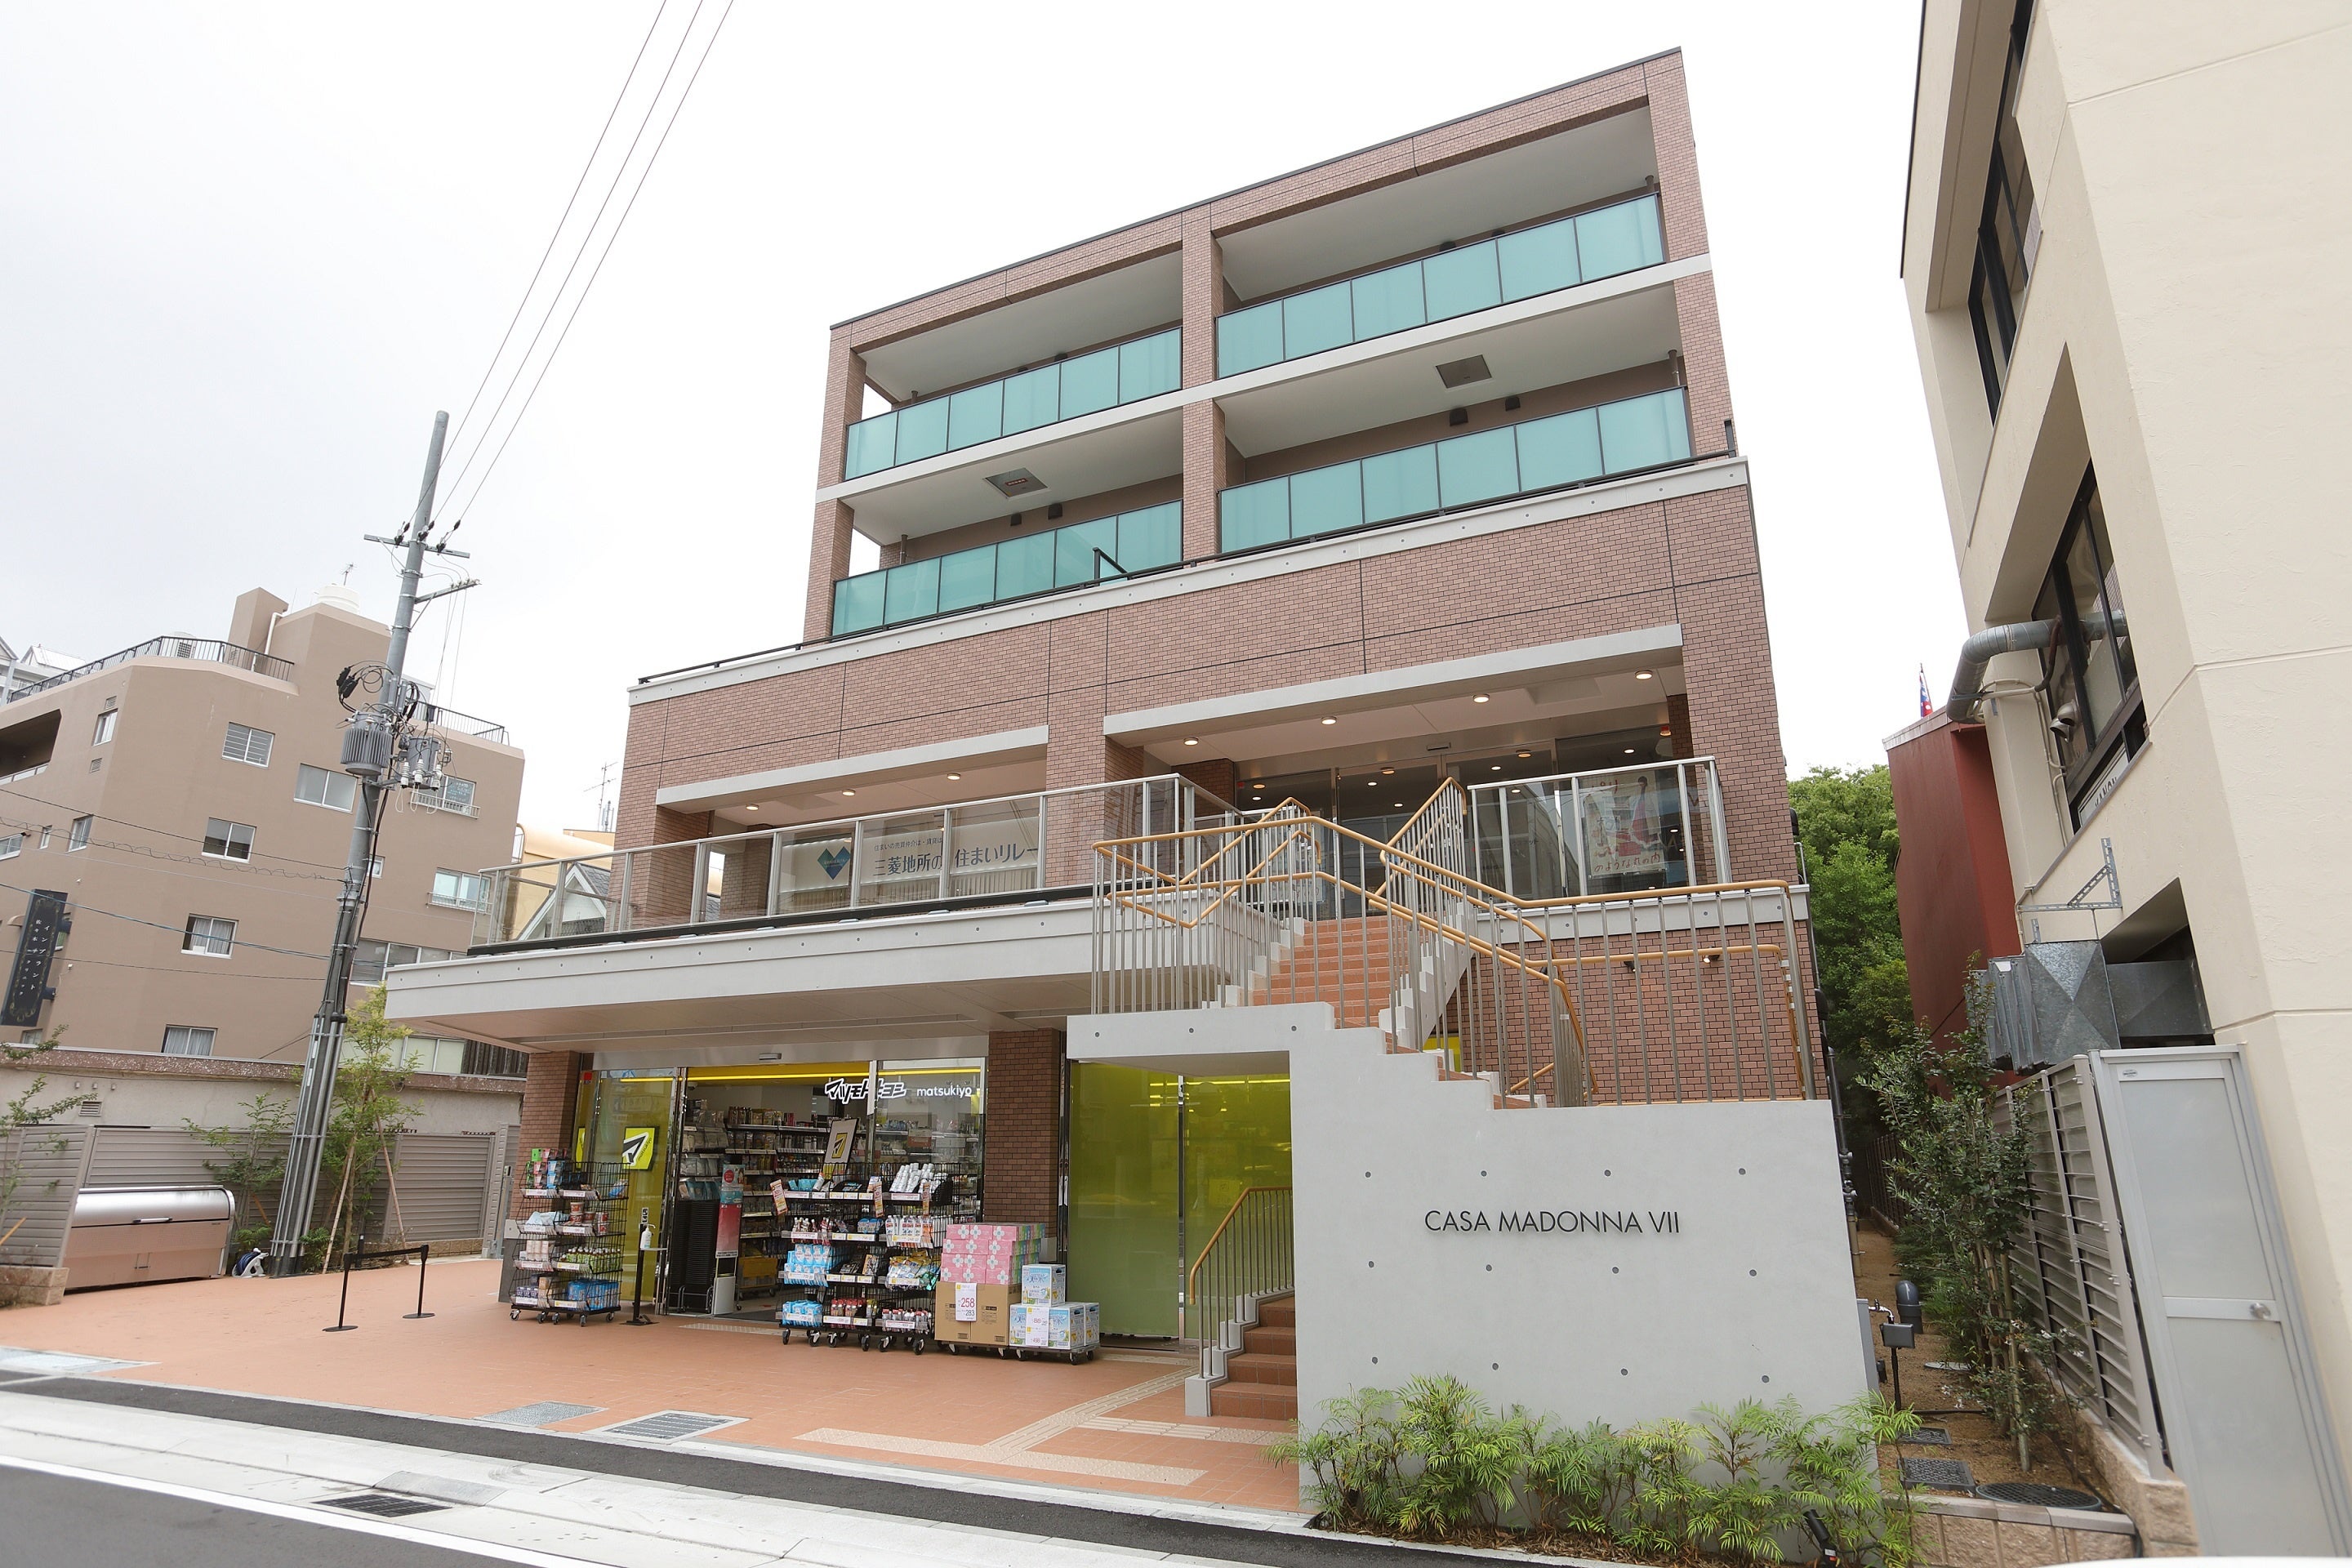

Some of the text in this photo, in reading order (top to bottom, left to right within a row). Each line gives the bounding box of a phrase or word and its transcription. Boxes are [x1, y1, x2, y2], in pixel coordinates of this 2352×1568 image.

[916, 1082, 973, 1099] matsukiyo
[1424, 1209, 1680, 1234] CASA MADONNA VII
[960, 1297, 975, 1308] 258
